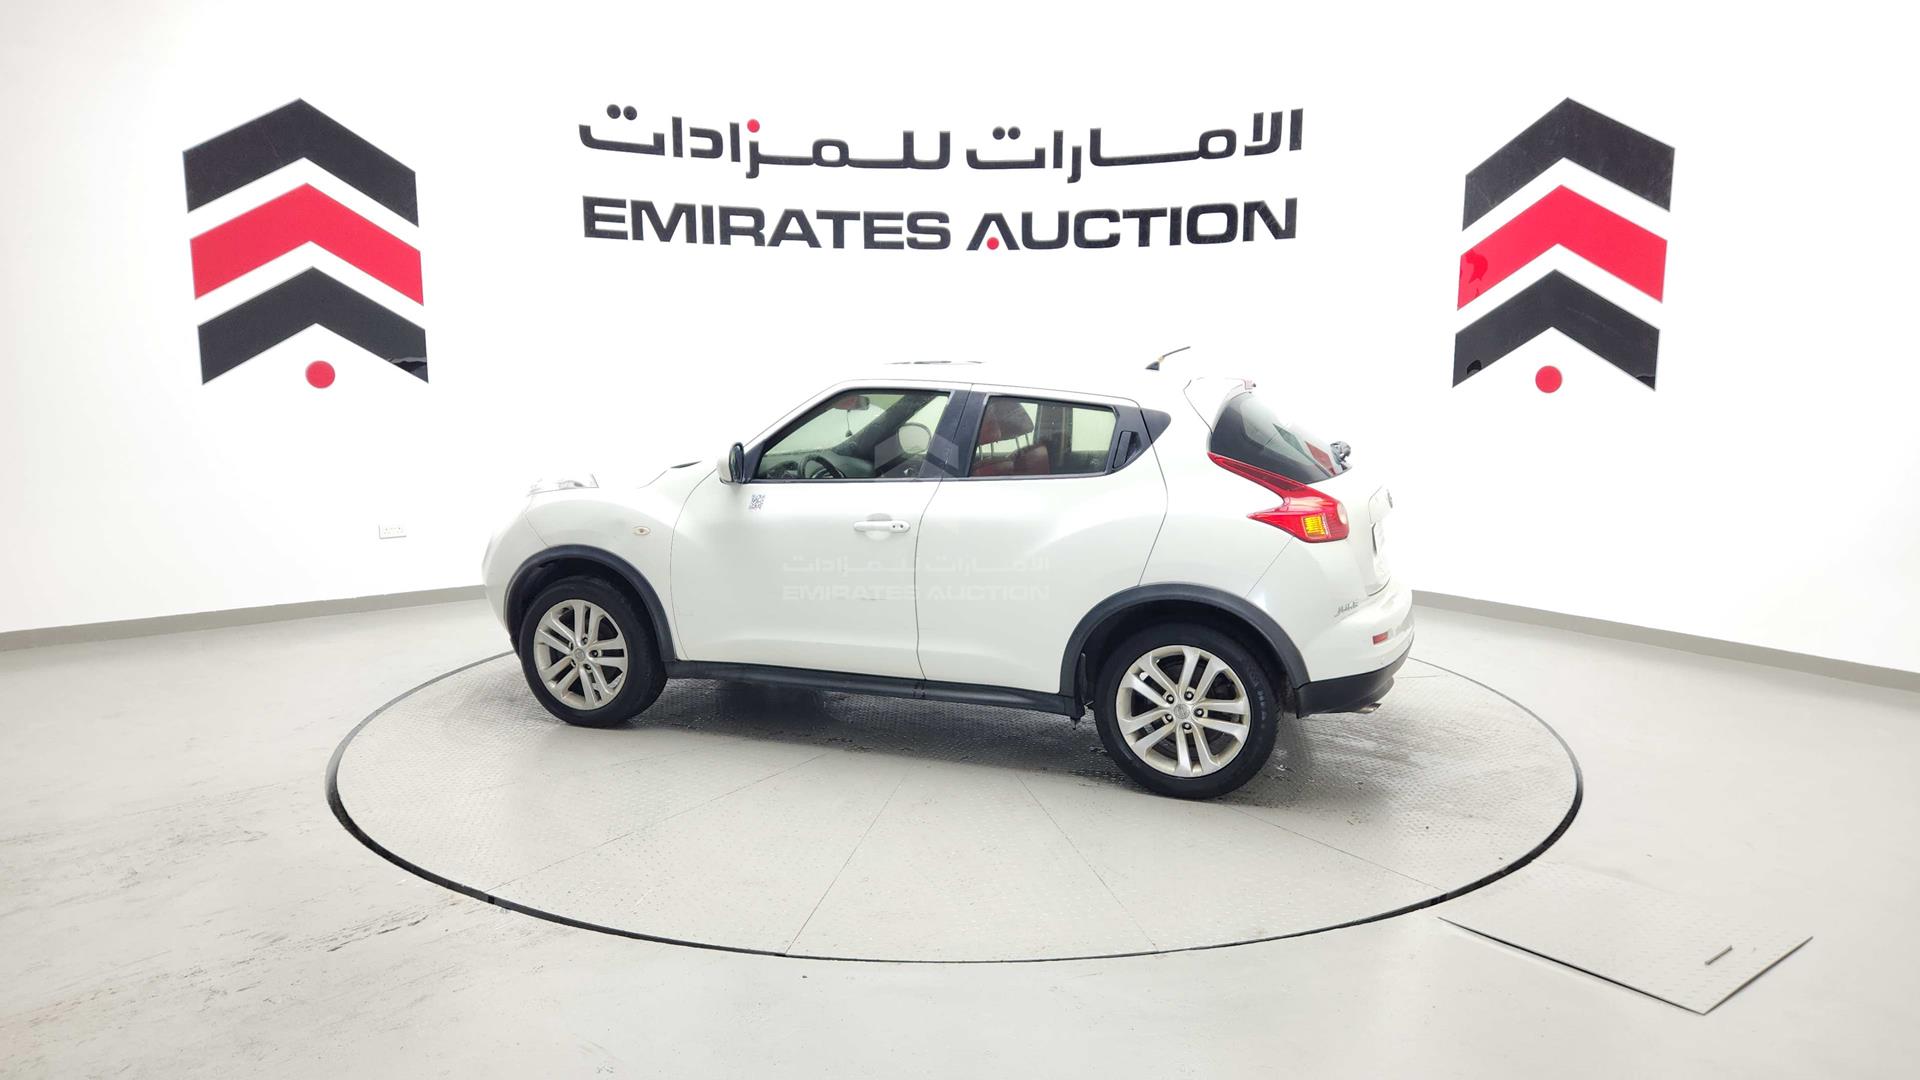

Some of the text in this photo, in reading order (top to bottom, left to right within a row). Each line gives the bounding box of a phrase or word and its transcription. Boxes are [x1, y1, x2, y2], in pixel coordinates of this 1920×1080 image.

[578, 104, 1304, 184] الامارات للمزادات
[582, 196, 1298, 251] EMIRATES AUCTION
